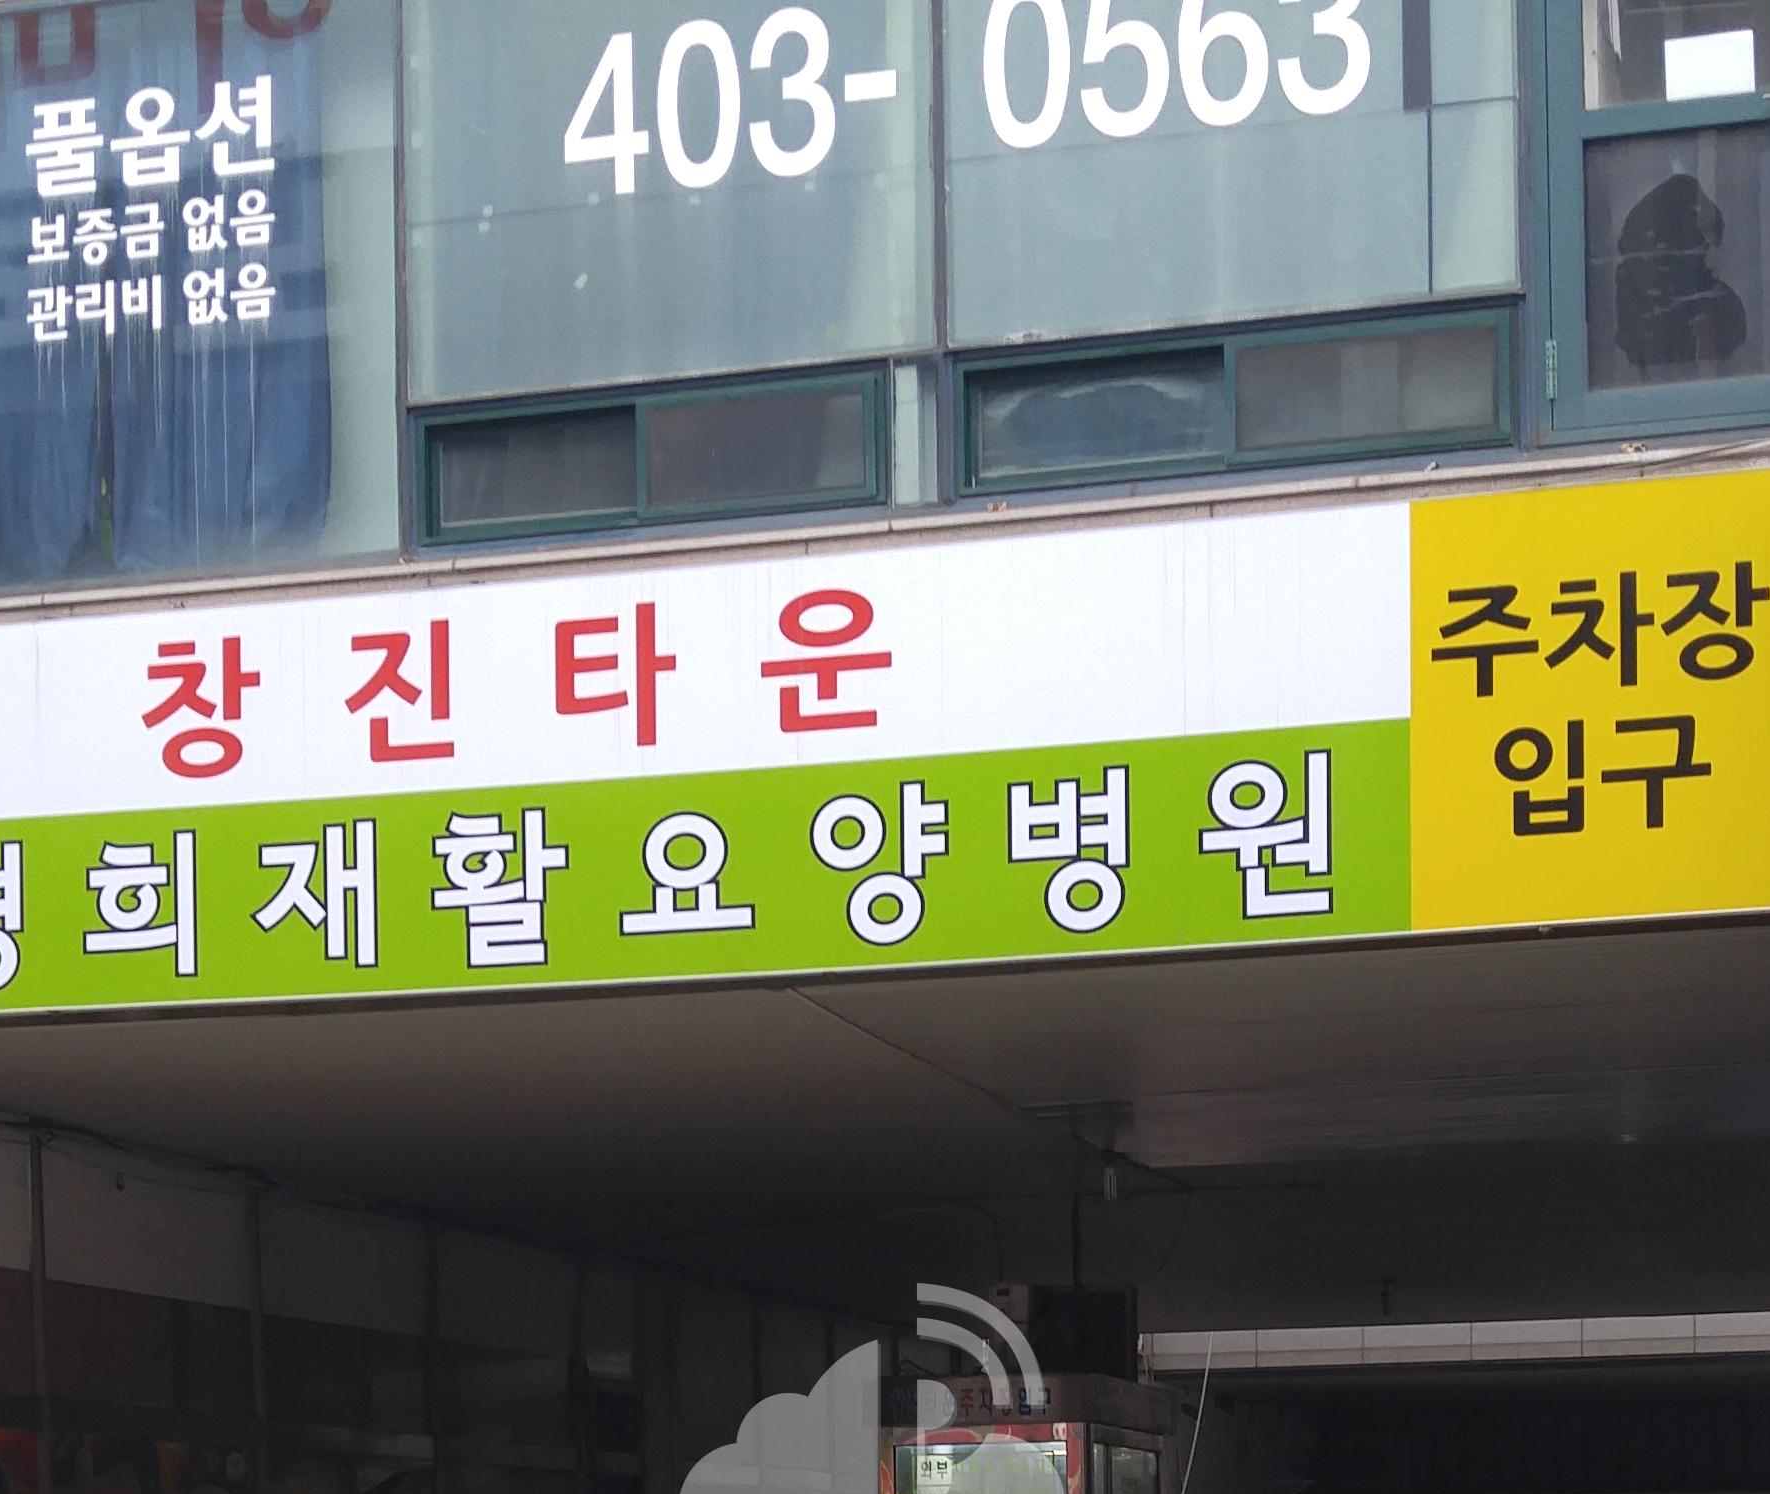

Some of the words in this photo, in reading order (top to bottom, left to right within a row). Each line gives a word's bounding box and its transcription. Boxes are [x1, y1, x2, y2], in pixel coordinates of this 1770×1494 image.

[26, 75, 275, 197] 풀옵션
[982, 0, 1370, 149] 0563
[28, 204, 165, 266] 보증금
[182, 190, 276, 255] 없음
[27, 280, 164, 343] 관리비
[182, 263, 276, 326] 없음
[141, 588, 892, 779] 창진타운
[1429, 559, 1770, 698] 주차장
[1491, 715, 1714, 838] 입구
